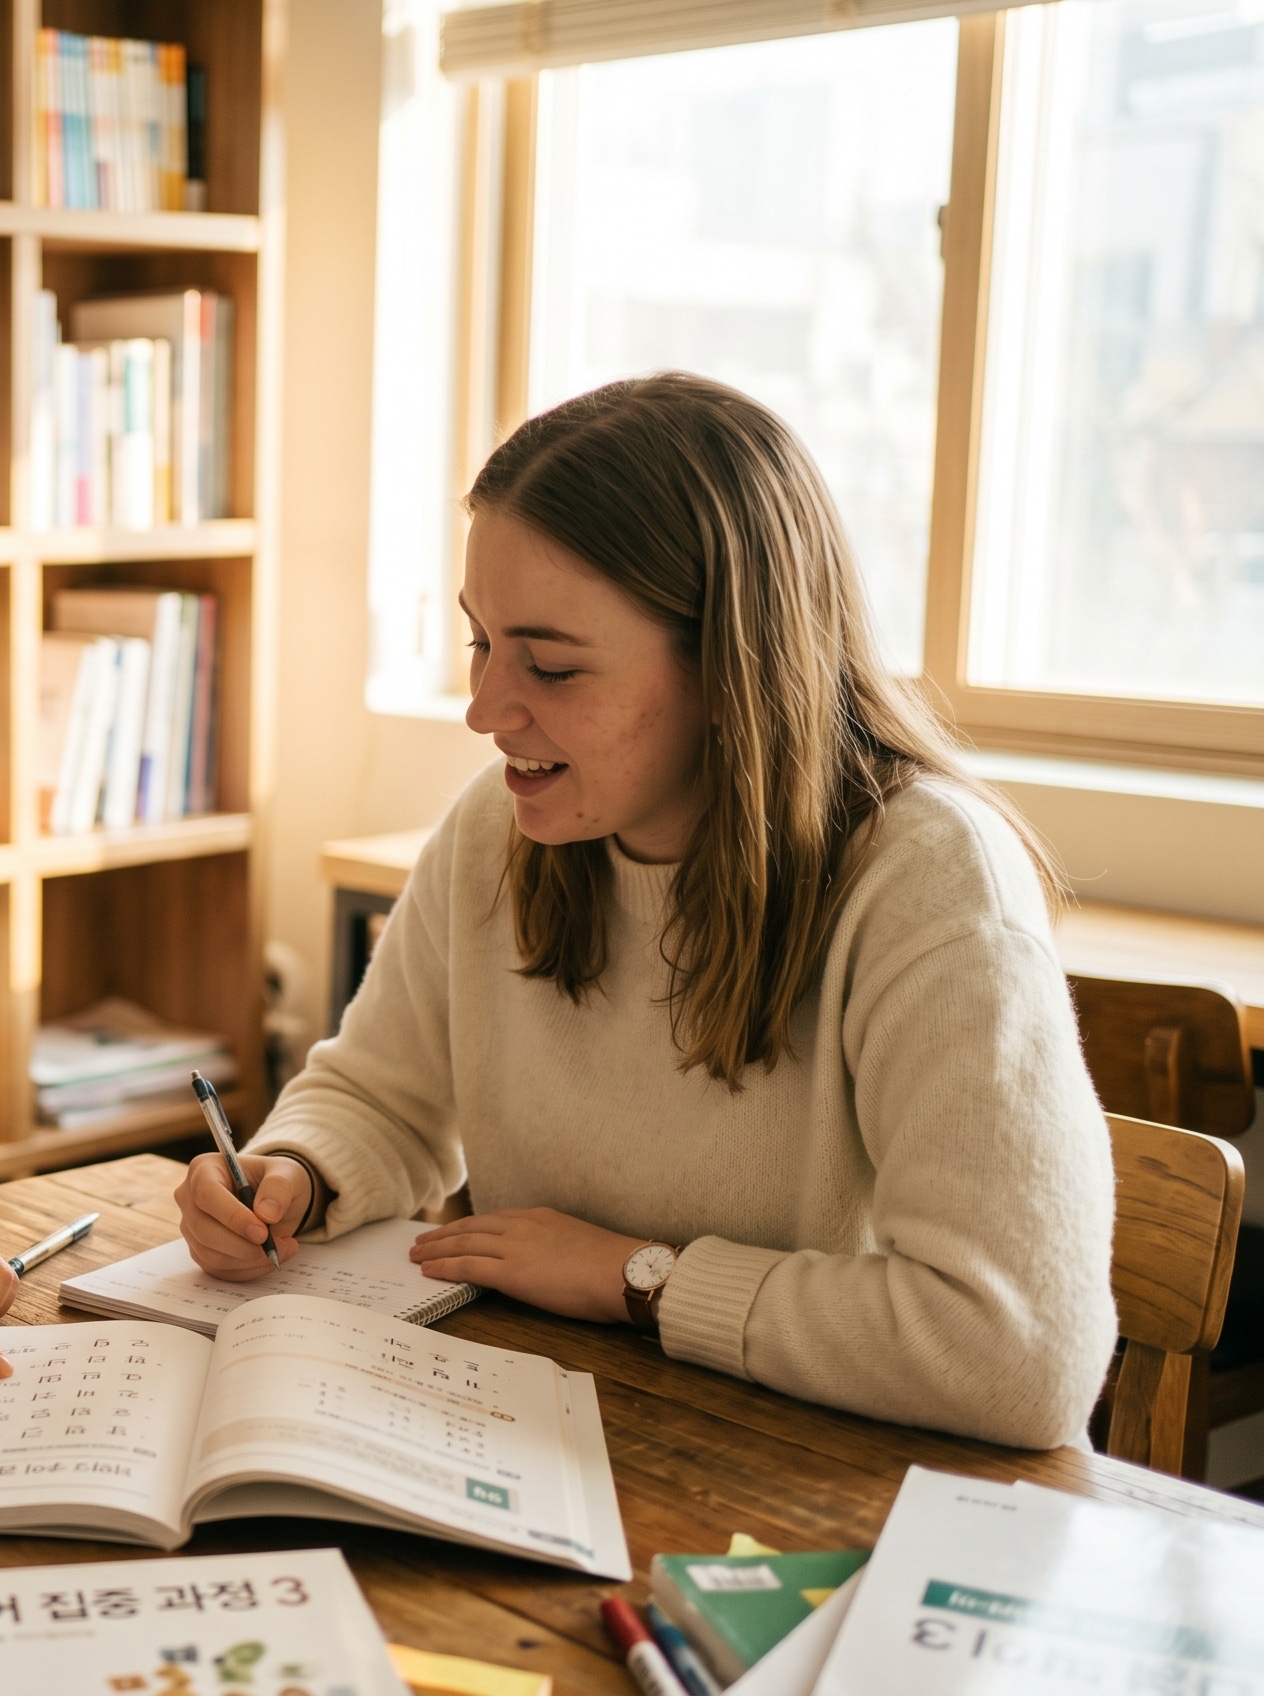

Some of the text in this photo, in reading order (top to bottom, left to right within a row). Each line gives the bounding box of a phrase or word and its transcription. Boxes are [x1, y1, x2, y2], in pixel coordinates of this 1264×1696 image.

[40, 1588, 140, 1621] 집중
[154, 1578, 262, 1612] 과정
[270, 1575, 310, 1606] 3
